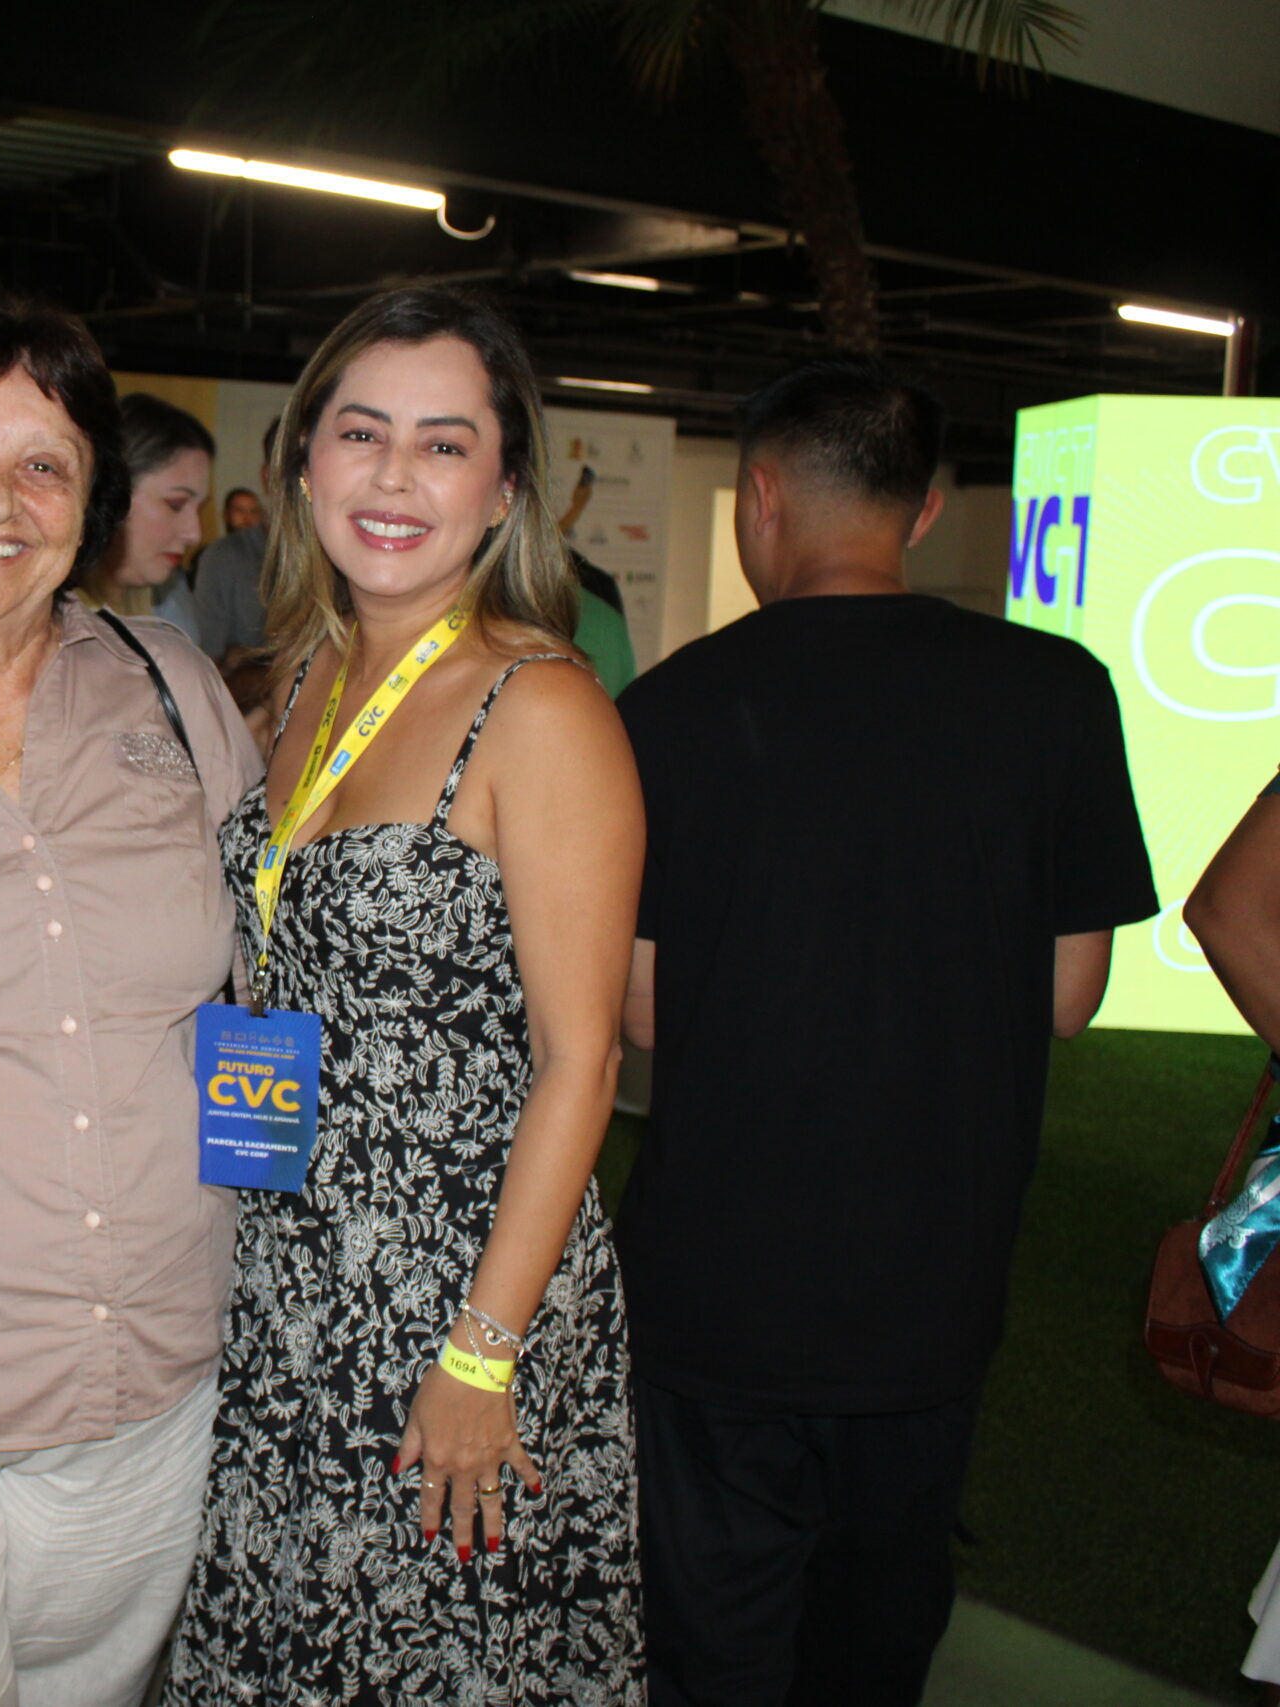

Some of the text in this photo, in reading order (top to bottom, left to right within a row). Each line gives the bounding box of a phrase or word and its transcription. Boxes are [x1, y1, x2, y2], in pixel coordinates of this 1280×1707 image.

[358, 704, 385, 737] CVC
[217, 1060, 275, 1076] FUTURO
[207, 1074, 301, 1112] CVC
[206, 1137, 298, 1153] MARCELA SACRAMENTO
[235, 1149, 249, 1157] CVC
[450, 1358, 476, 1374] 1694
